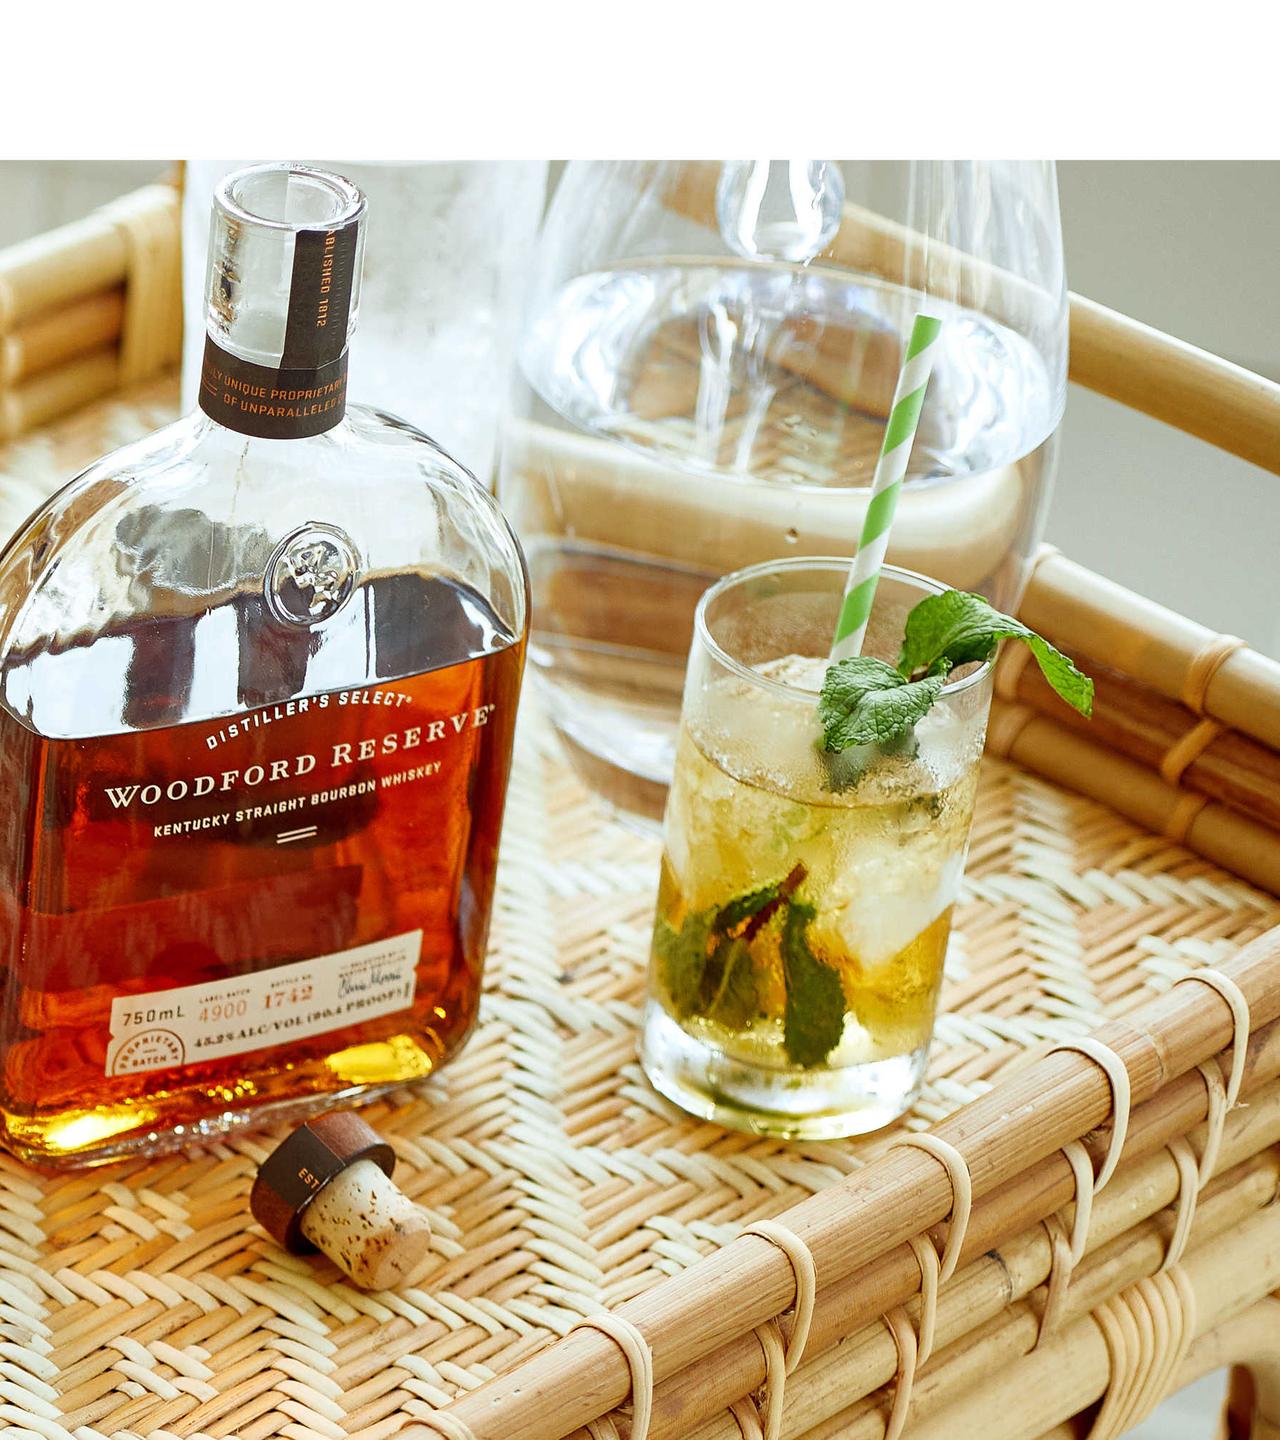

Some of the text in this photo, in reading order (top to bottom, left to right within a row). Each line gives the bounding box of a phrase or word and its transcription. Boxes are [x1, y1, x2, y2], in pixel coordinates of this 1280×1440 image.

[316, 298, 329, 328] 1812
[224, 375, 266, 399] UNIQUE
[223, 393, 336, 418] OF UNPARALLELED
[206, 694, 330, 750] DISTILLER'S
[104, 705, 490, 809] WOODFORD RESERVE
[153, 760, 442, 838] KENTUCKY STRAIGHT BOURBON WHISKEY
[265, 984, 313, 1009] 1742
[122, 1005, 185, 1027] 750mL
[198, 999, 248, 1024] 4900
[132, 1055, 168, 1067] BATCH
[298, 1167, 320, 1189] EST
